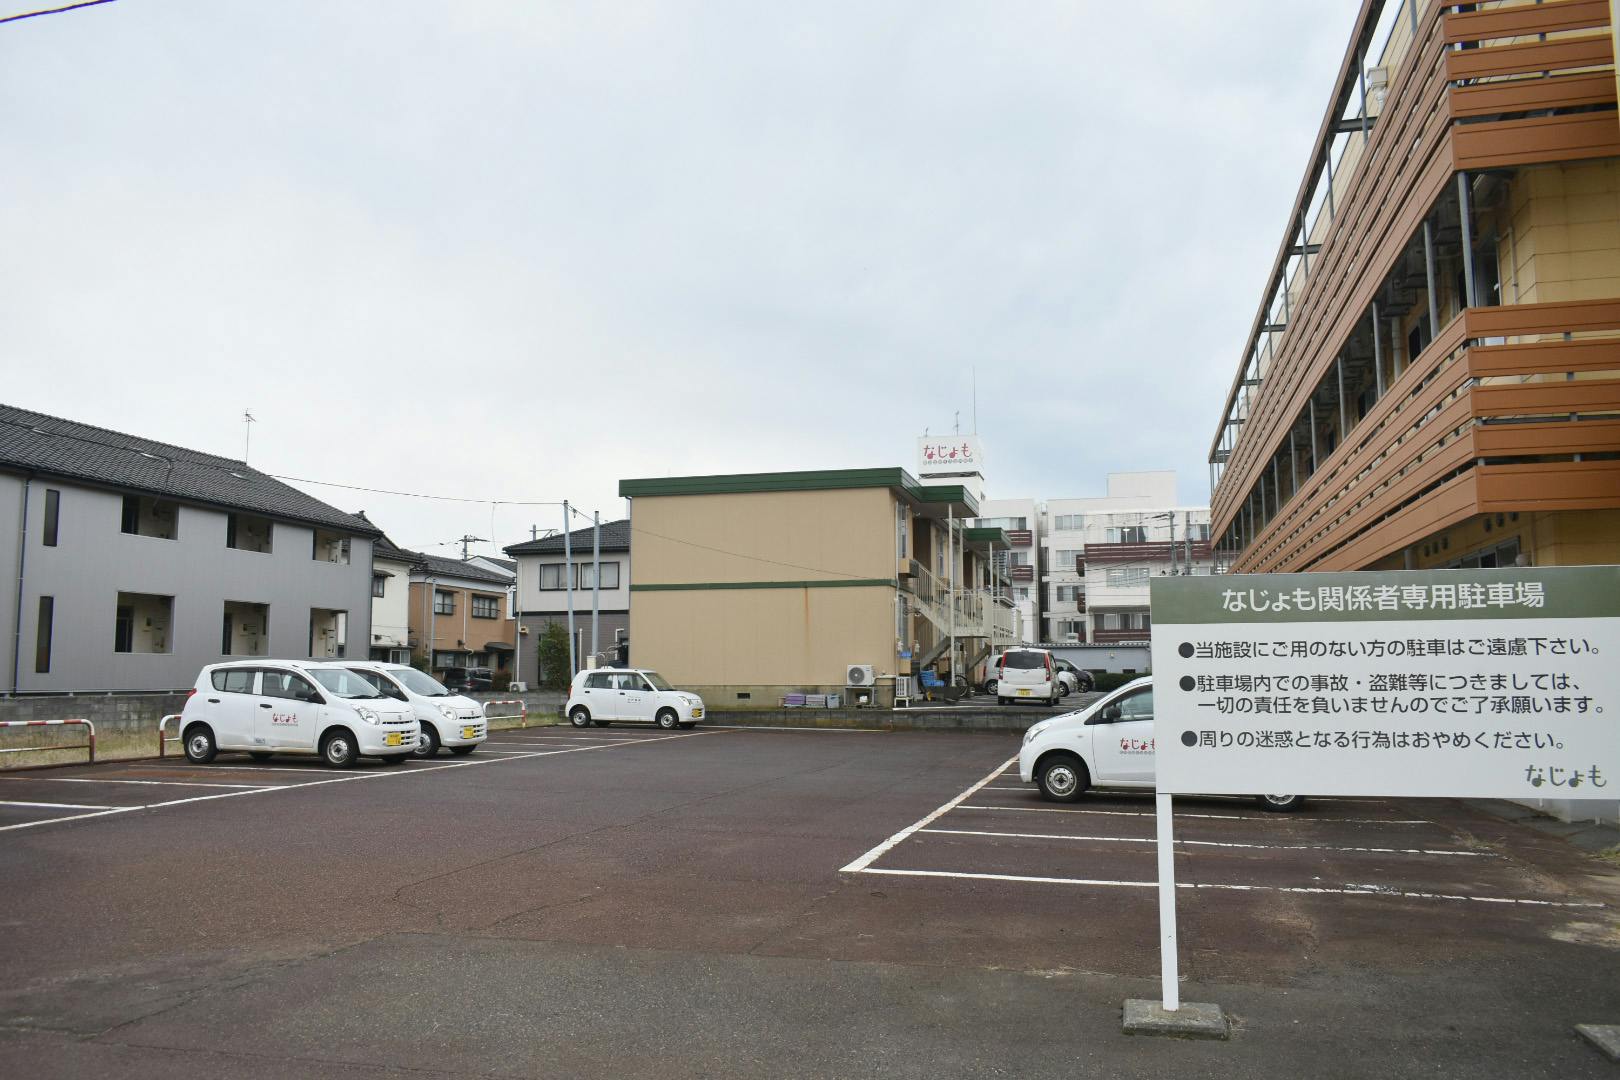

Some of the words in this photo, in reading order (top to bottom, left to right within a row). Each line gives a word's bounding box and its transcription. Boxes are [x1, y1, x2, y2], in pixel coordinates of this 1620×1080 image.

[923, 443, 972, 459] なじょも
[1222, 582, 1545, 612] なじょも関係者専用駐車場
[1195, 637, 1599, 659] 当施設にご用のない方の駐車はご遠慮下さい。
[1197, 673, 1581, 692] 駐車場内での事故・盗難等につきましては、
[1198, 696, 1603, 714] 一切の責任を負いませんのでご了承願います。
[1199, 731, 1563, 749] 周りの迷惑となる行為はおやめください。
[1525, 764, 1607, 788] なじょも
